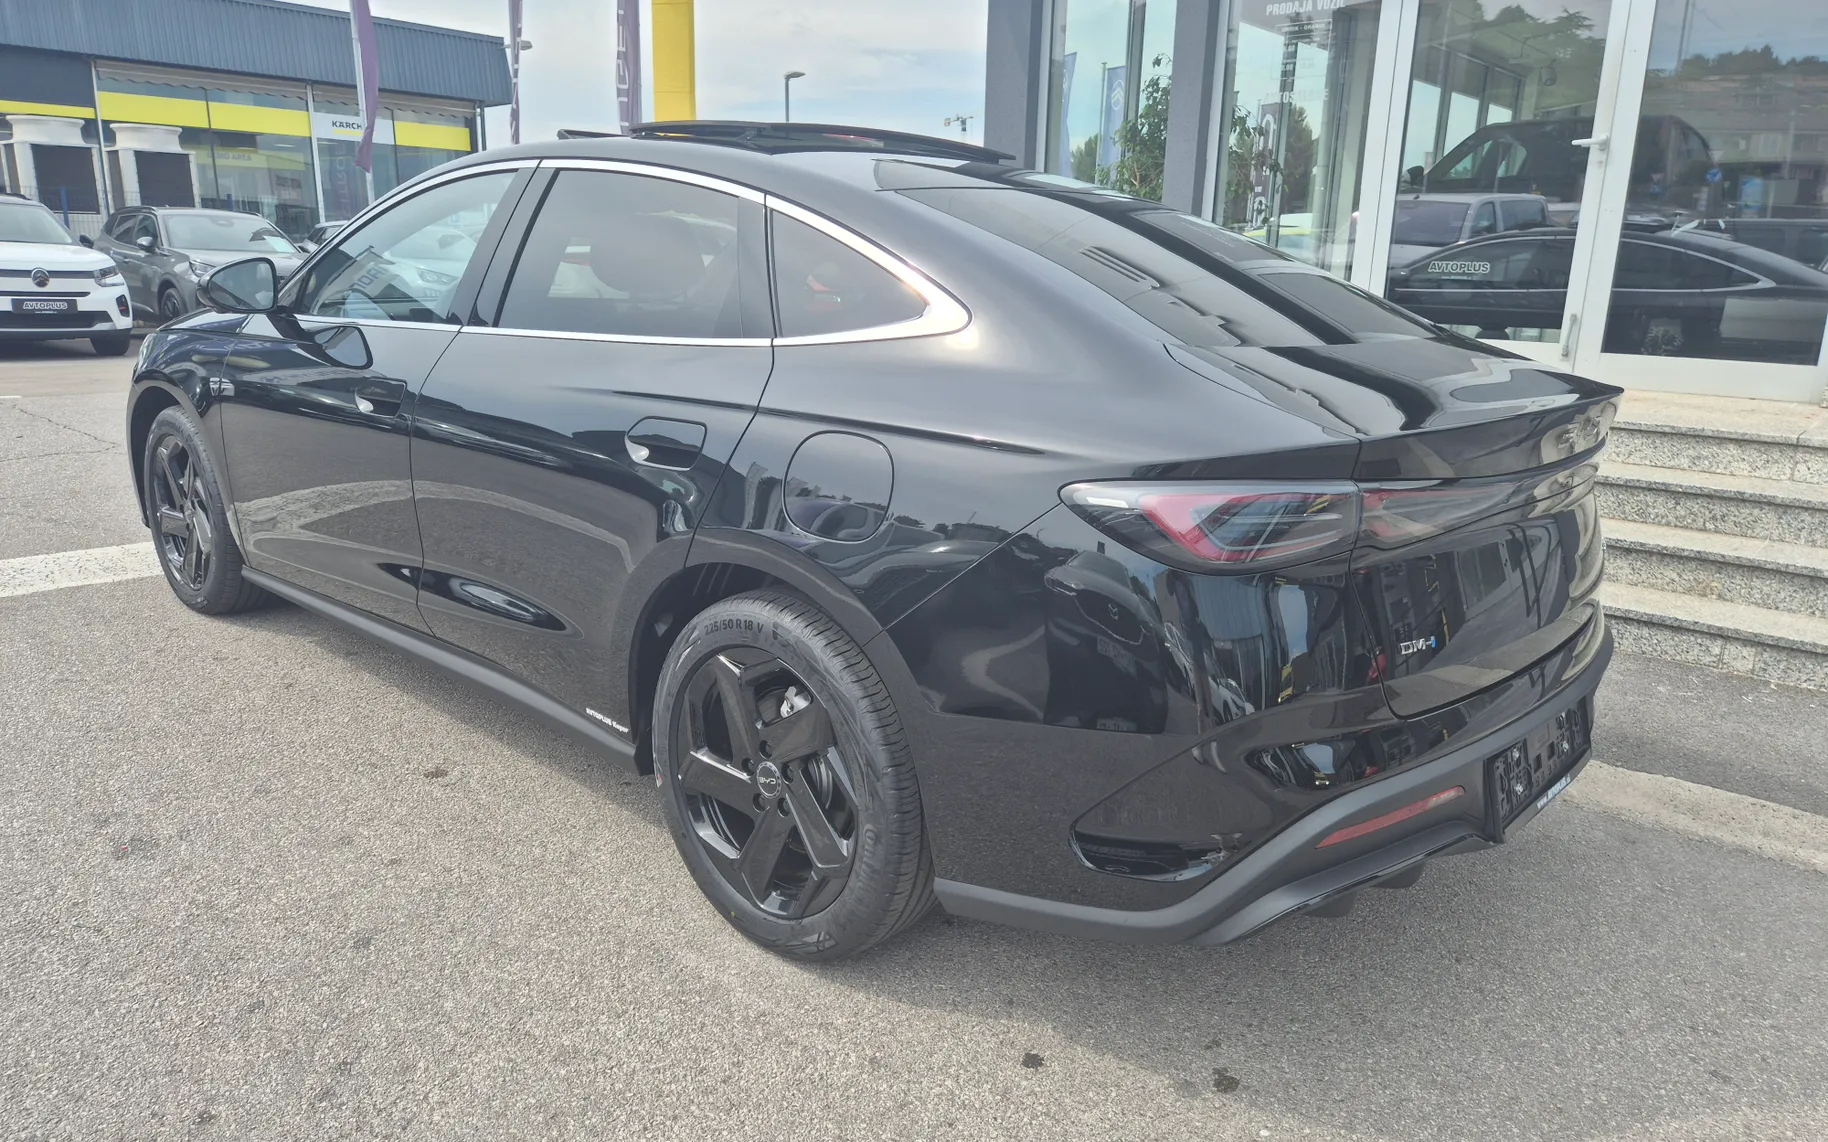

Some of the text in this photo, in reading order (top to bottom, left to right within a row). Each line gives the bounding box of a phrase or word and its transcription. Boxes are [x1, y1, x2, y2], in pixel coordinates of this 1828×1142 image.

[1265, 0, 1313, 17] PRODAJA
[331, 119, 363, 131] KÄRCH
[1428, 261, 1491, 274] AVTOPLUS
[23, 301, 68, 310] AVTOPLUS
[704, 618, 734, 635] 225/50
[744, 619, 754, 631] 18
